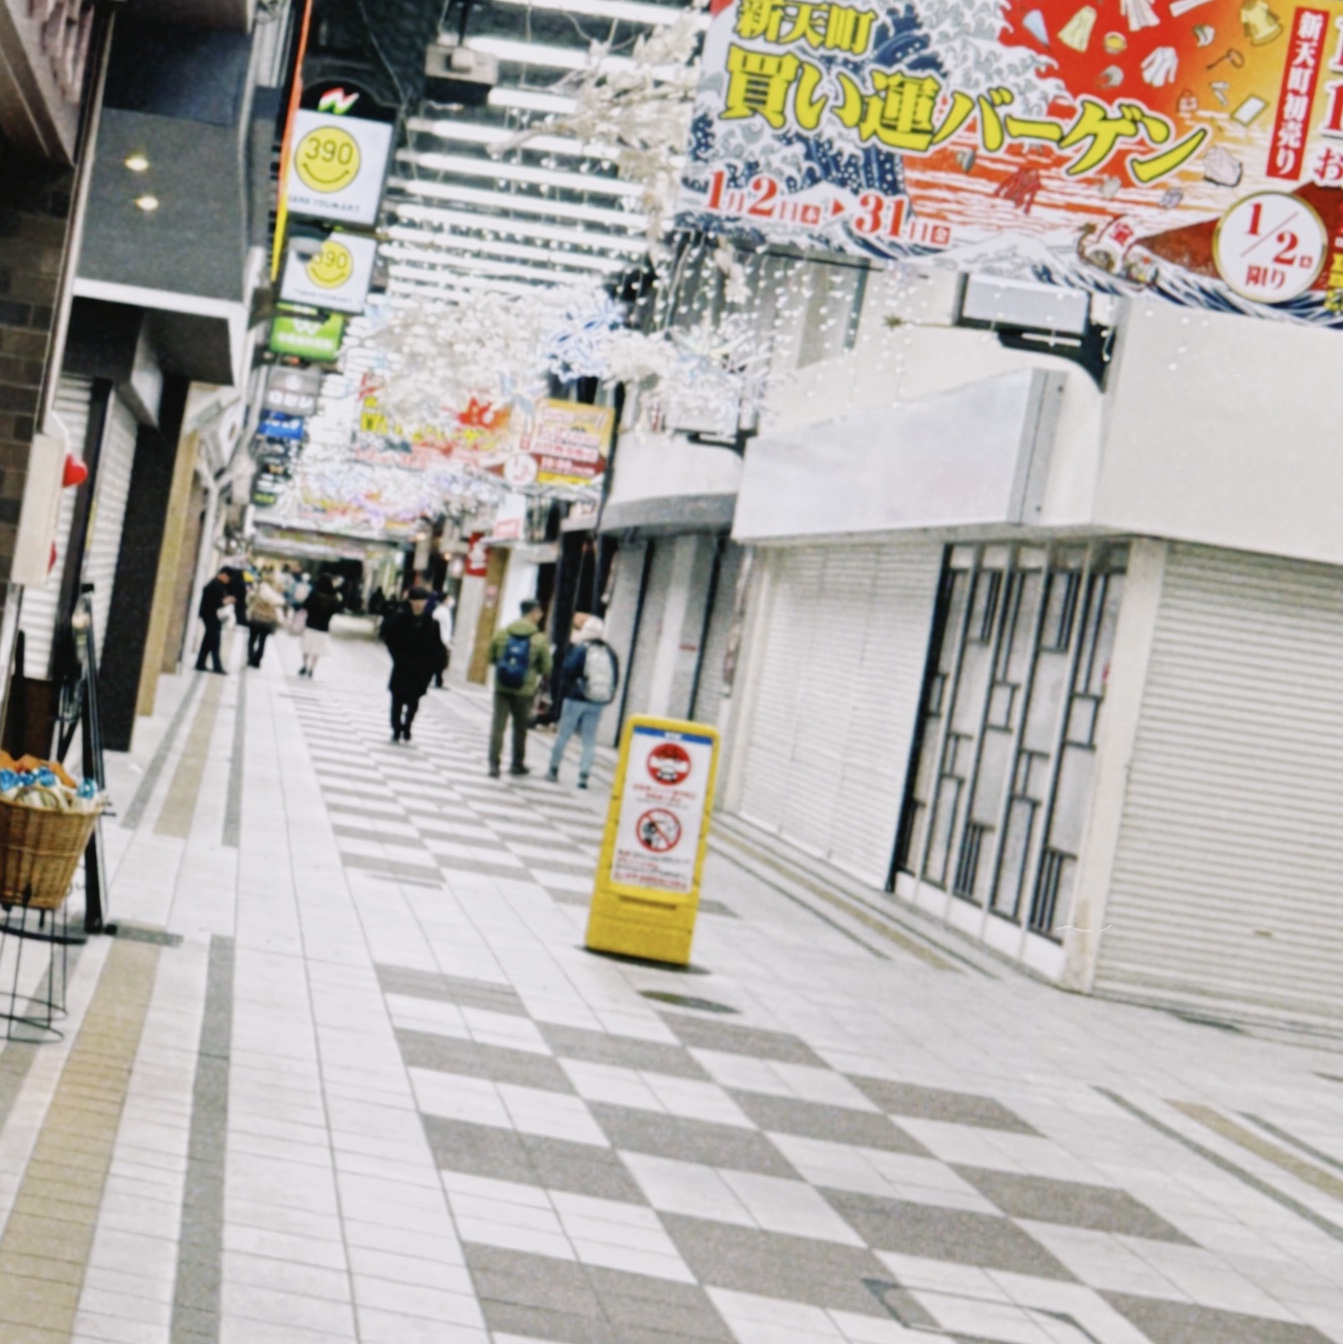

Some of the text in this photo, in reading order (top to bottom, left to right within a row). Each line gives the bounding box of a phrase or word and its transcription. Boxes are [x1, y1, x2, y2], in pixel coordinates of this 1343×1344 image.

[718, 43, 1207, 182] 買い運バーゲン
[1276, 11, 1324, 175] 新天町初売り
[305, 136, 355, 166] 390
[1245, 264, 1287, 290] 限り
